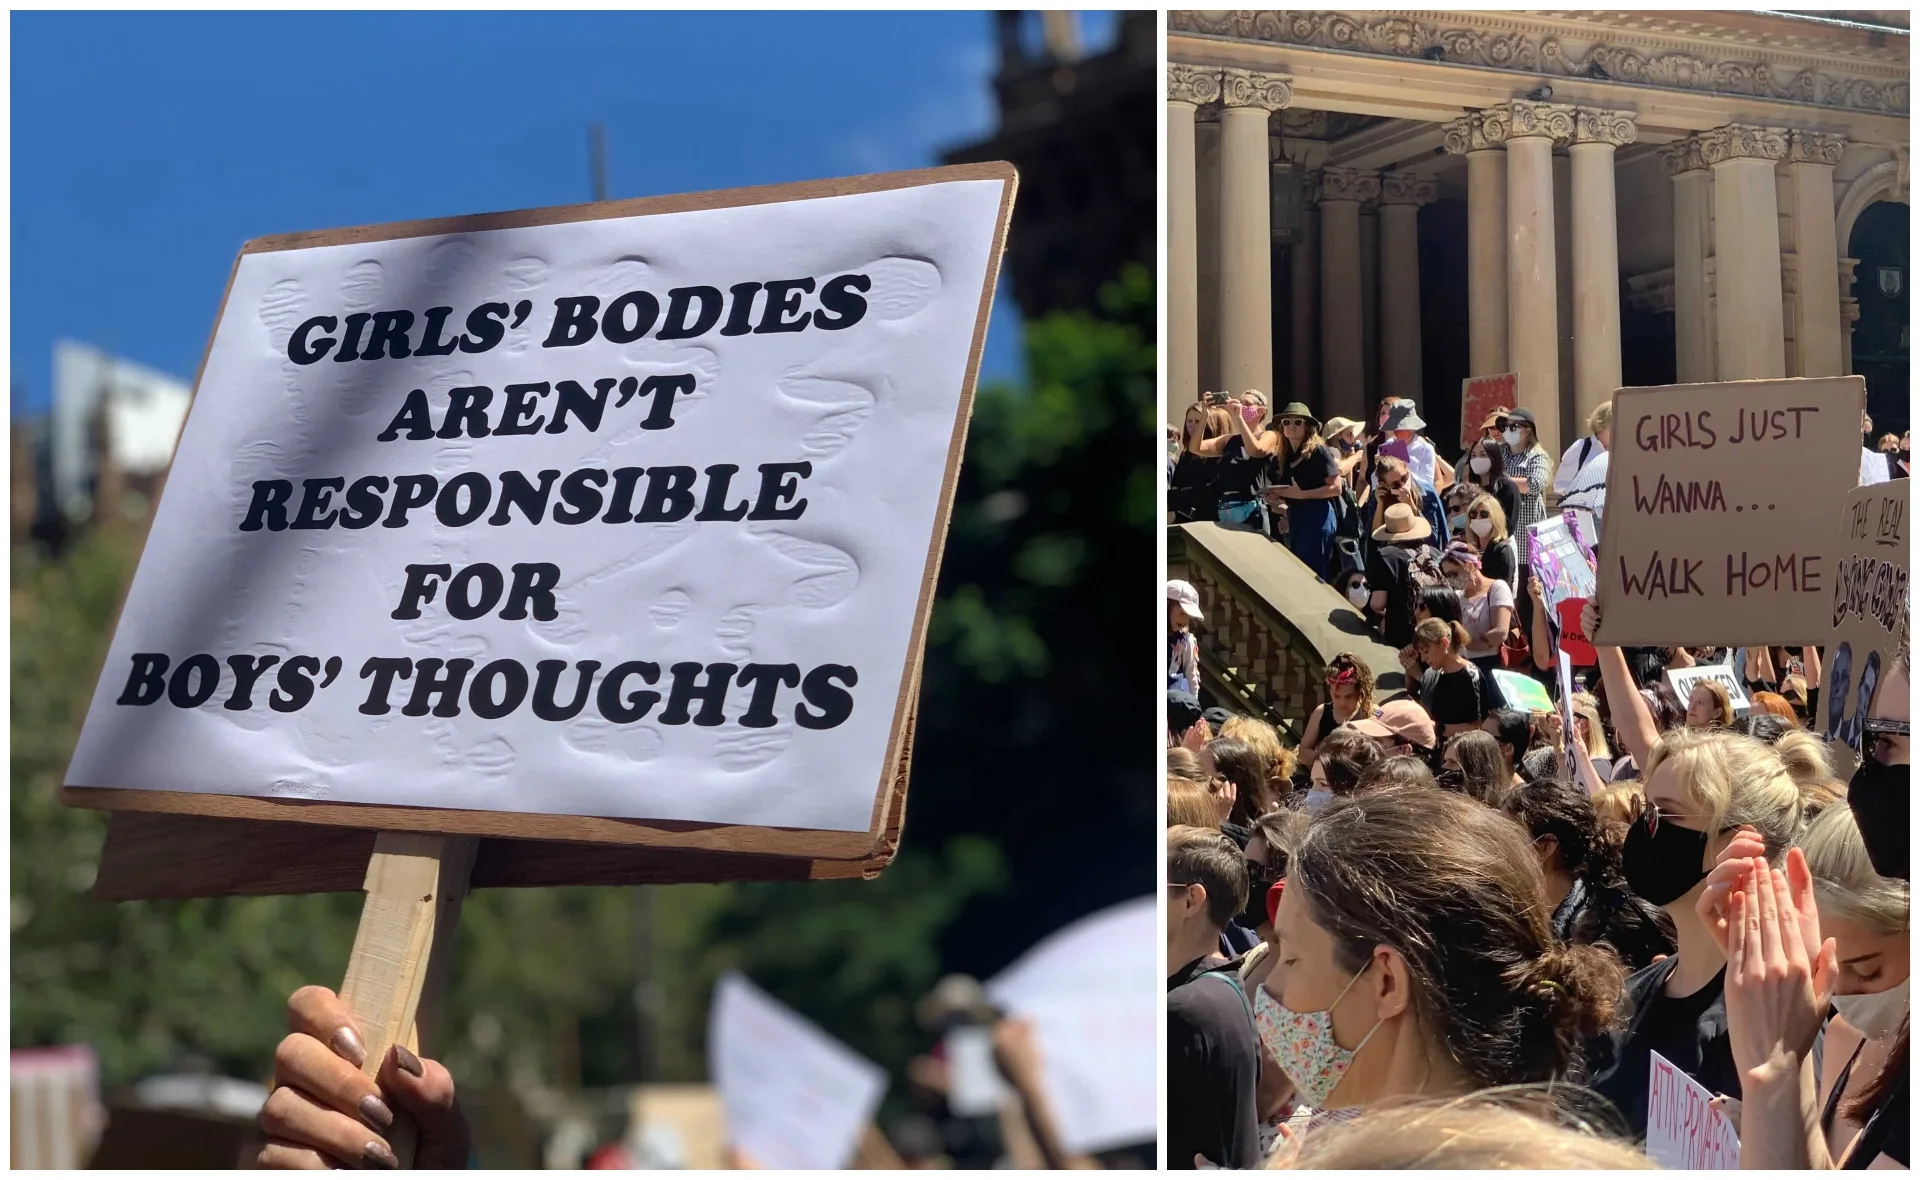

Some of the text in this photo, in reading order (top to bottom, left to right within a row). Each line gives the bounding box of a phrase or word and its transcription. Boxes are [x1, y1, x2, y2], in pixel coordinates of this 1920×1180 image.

[541, 273, 872, 349] BODIES
[1635, 407, 1820, 452] GIRLS JUST
[238, 460, 813, 533] RESPONSIBLE
[1850, 497, 1904, 541] THE REAL
[390, 561, 561, 622] FOR
[1619, 551, 1822, 600] WALK HOME
[357, 656, 859, 731] THOUGHTS
